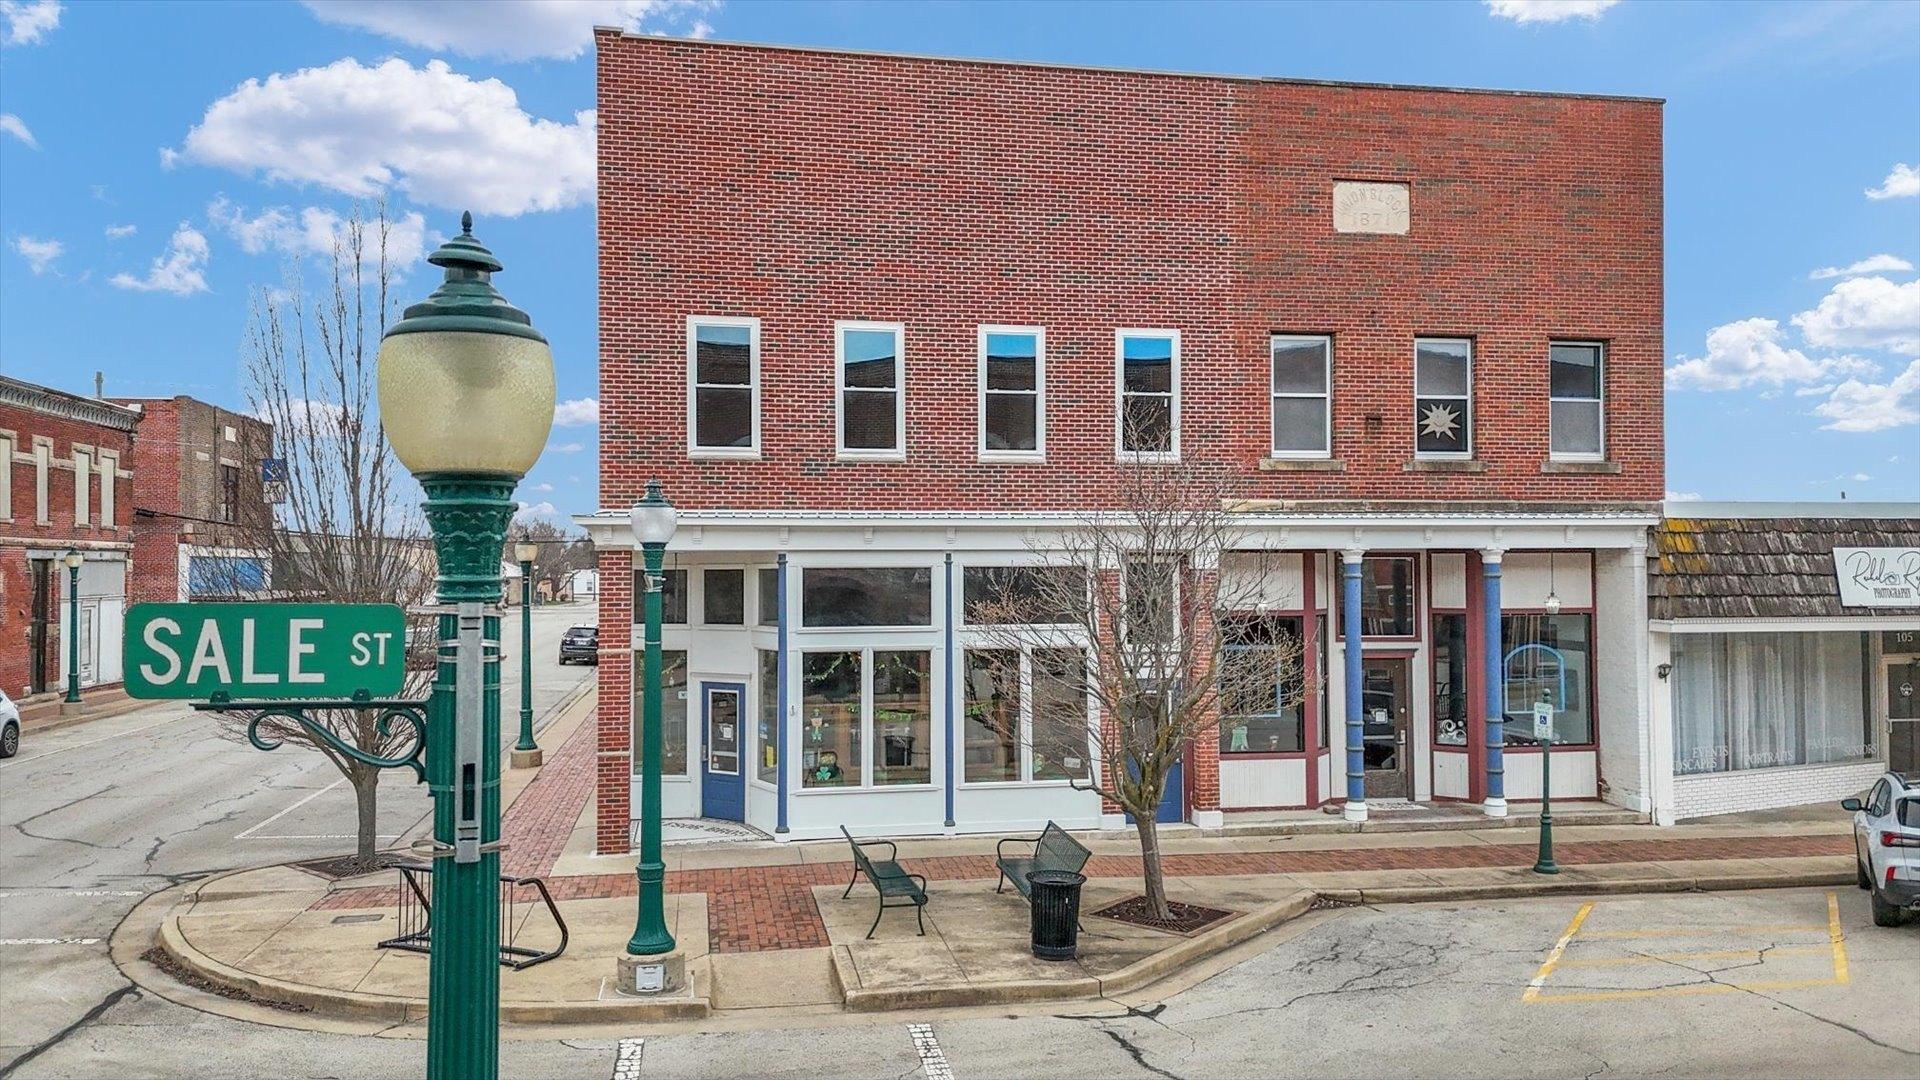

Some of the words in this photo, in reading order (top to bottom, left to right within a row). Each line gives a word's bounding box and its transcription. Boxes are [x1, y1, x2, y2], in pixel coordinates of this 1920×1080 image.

[1370, 188, 1408, 217] BLOCK
[1873, 587, 1912, 599] PHOTOGRAPHY
[1896, 632, 1914, 643] 105
[139, 616, 326, 686] SALE
[350, 631, 393, 667] ST
[1692, 745, 1729, 759] EVENTS
[1744, 750, 1794, 766] PORTRAITS
